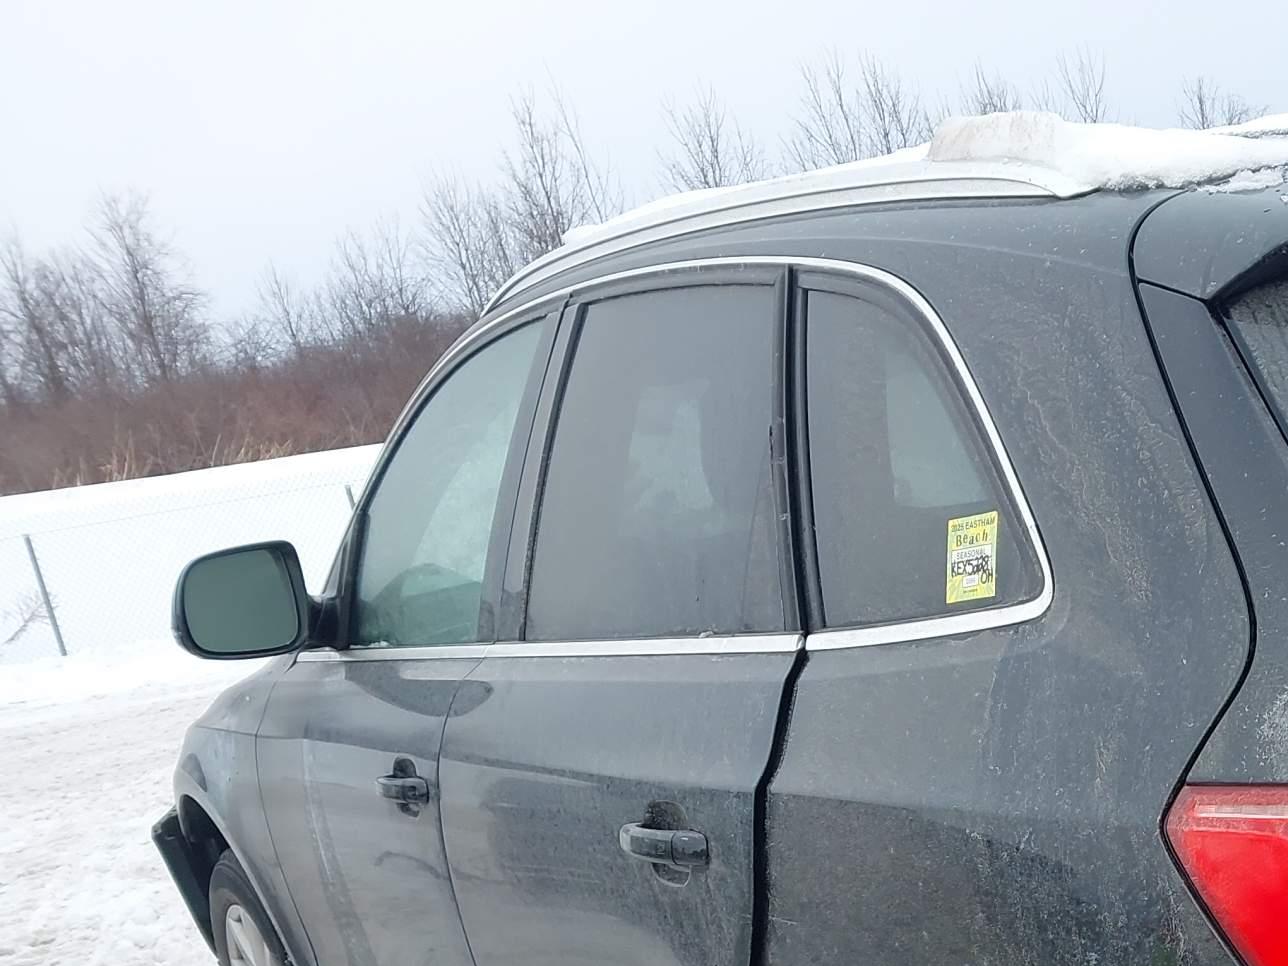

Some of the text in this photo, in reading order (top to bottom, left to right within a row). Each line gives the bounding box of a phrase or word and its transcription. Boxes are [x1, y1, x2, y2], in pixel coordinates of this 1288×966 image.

[965, 517, 996, 530] EASTHAM
[956, 529, 988, 547] Beach
[956, 548, 987, 560] SEASONAL
